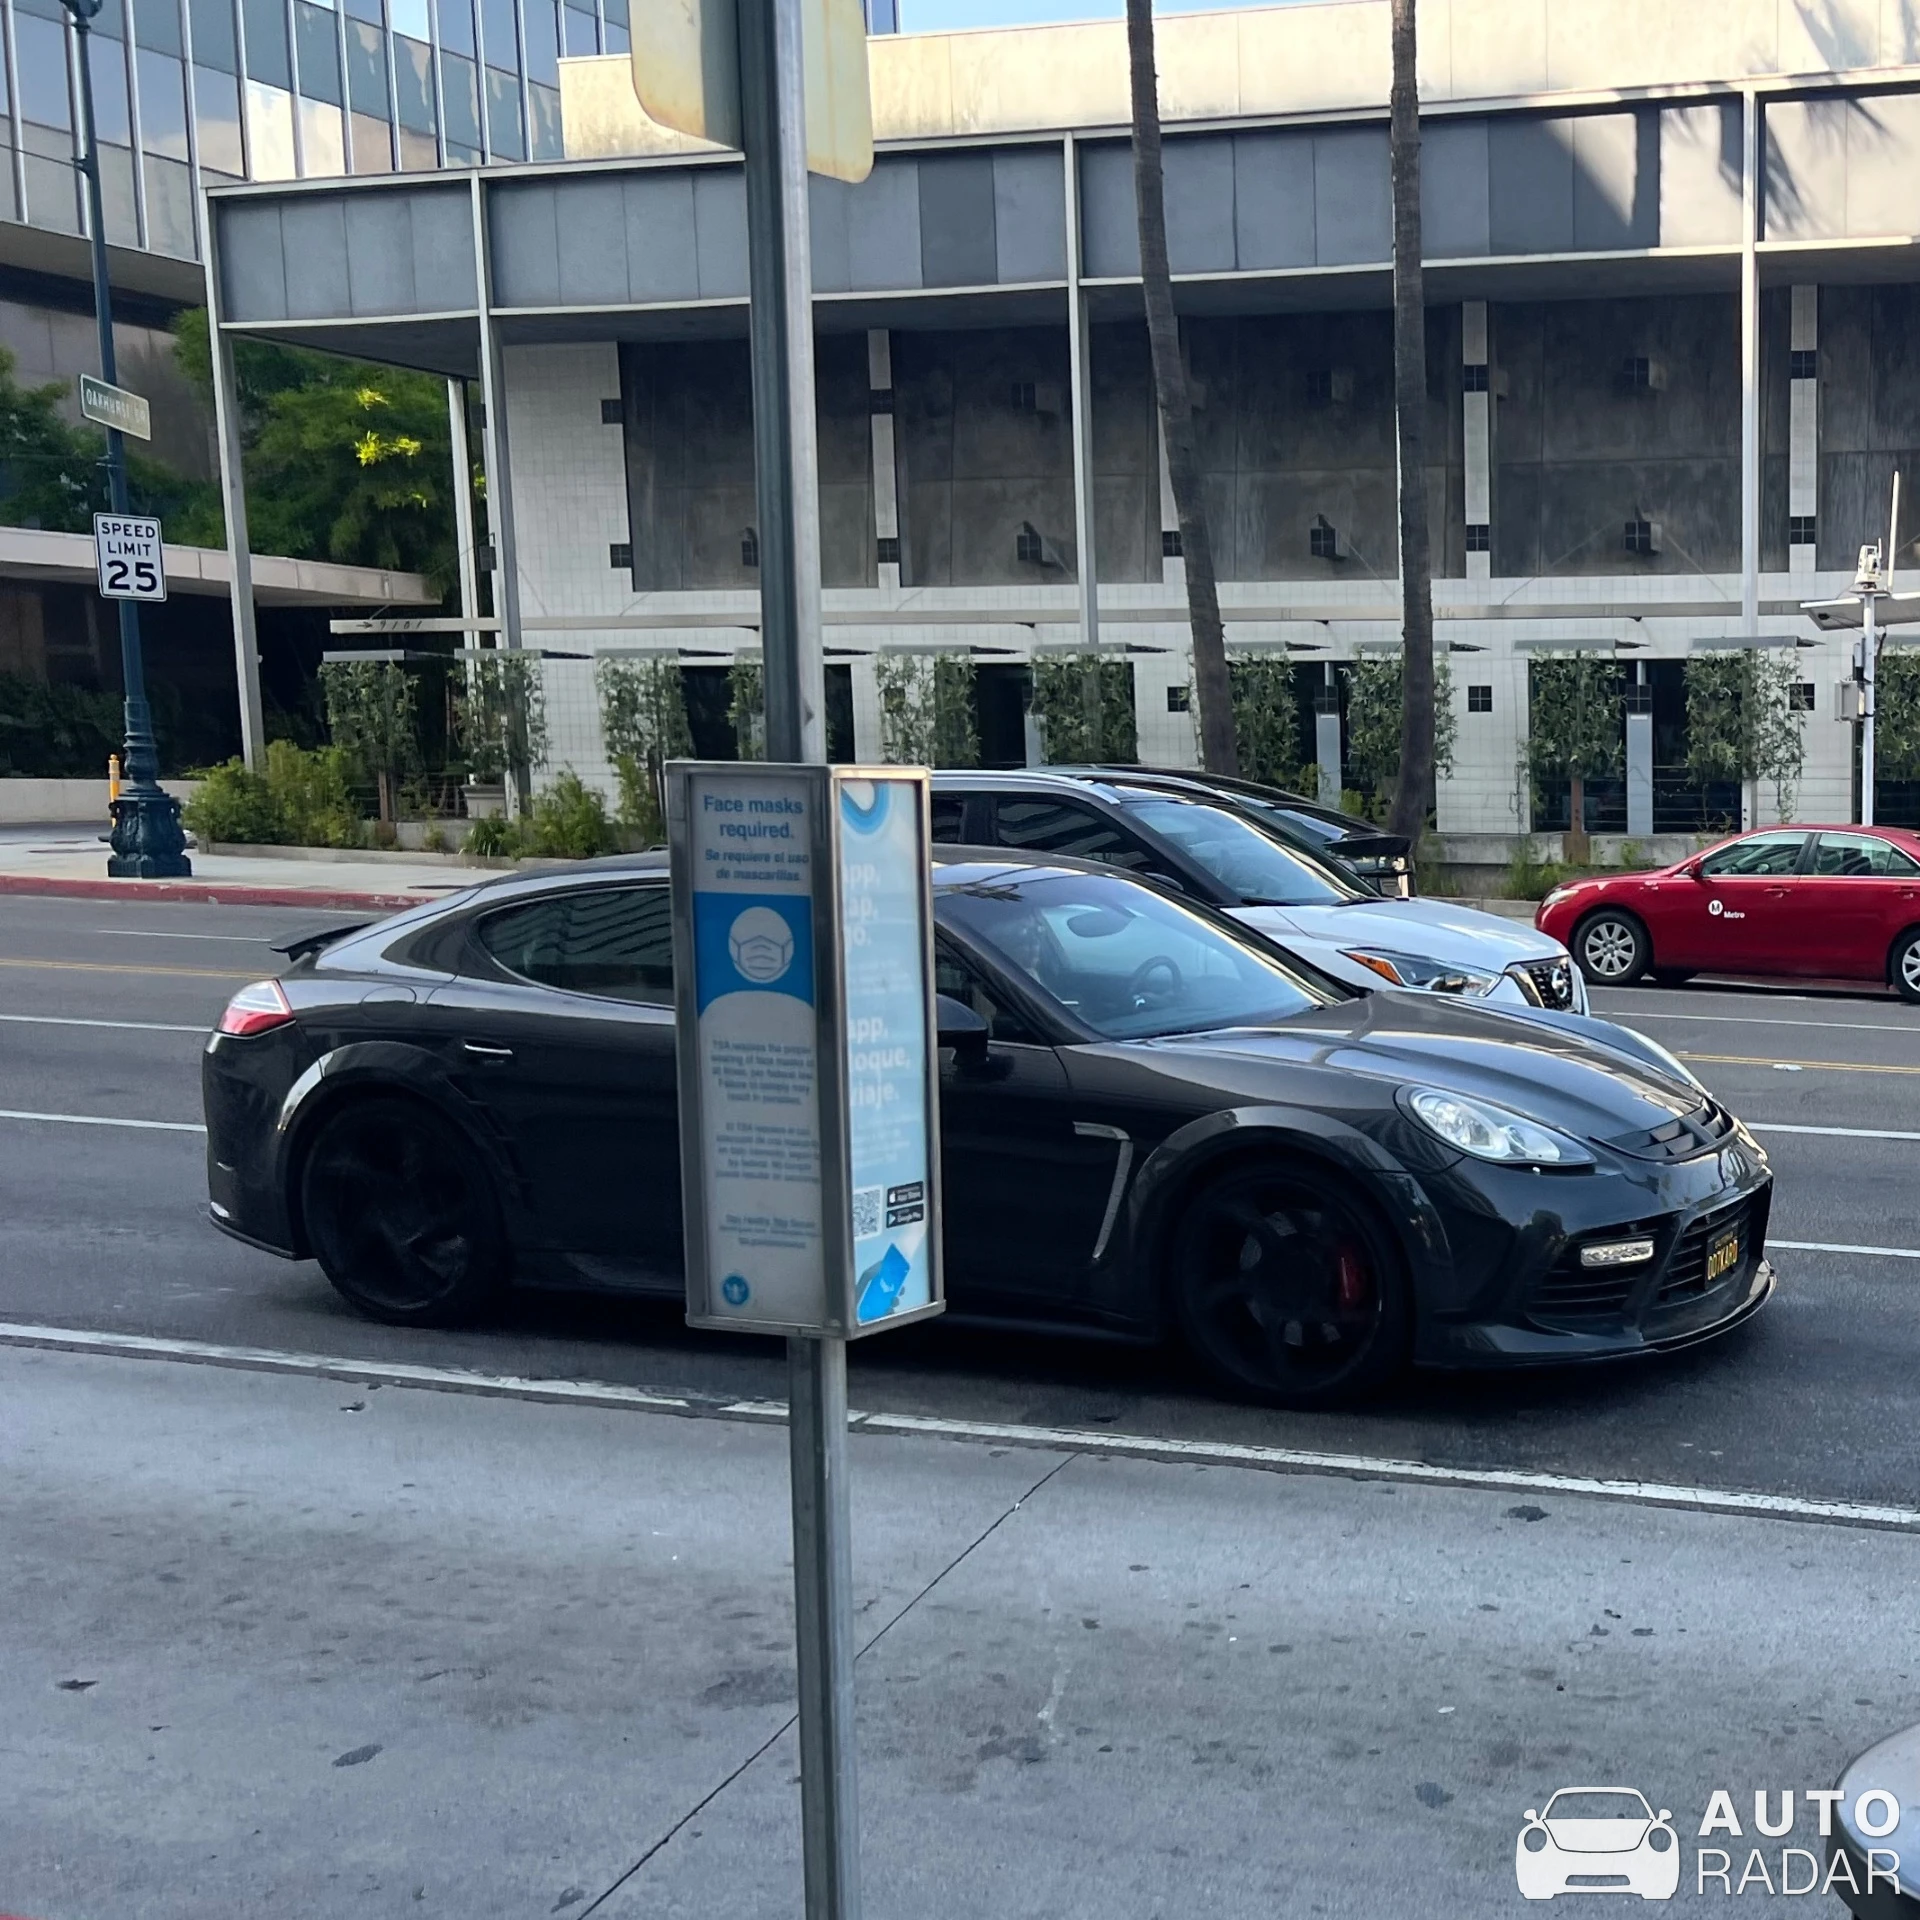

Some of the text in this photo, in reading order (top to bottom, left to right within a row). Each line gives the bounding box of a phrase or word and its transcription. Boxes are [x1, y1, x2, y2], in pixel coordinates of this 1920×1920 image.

[102, 522, 156, 538] SPEED
[107, 540, 151, 557] LIMIT
[106, 560, 158, 592] 25
[704, 794, 804, 814] Face masks
[719, 821, 795, 841] required.
[705, 848, 810, 864] Se requiere el uso
[716, 866, 731, 879] de
[1723, 910, 1746, 919] Metro
[850, 1046, 911, 1083] oque,
